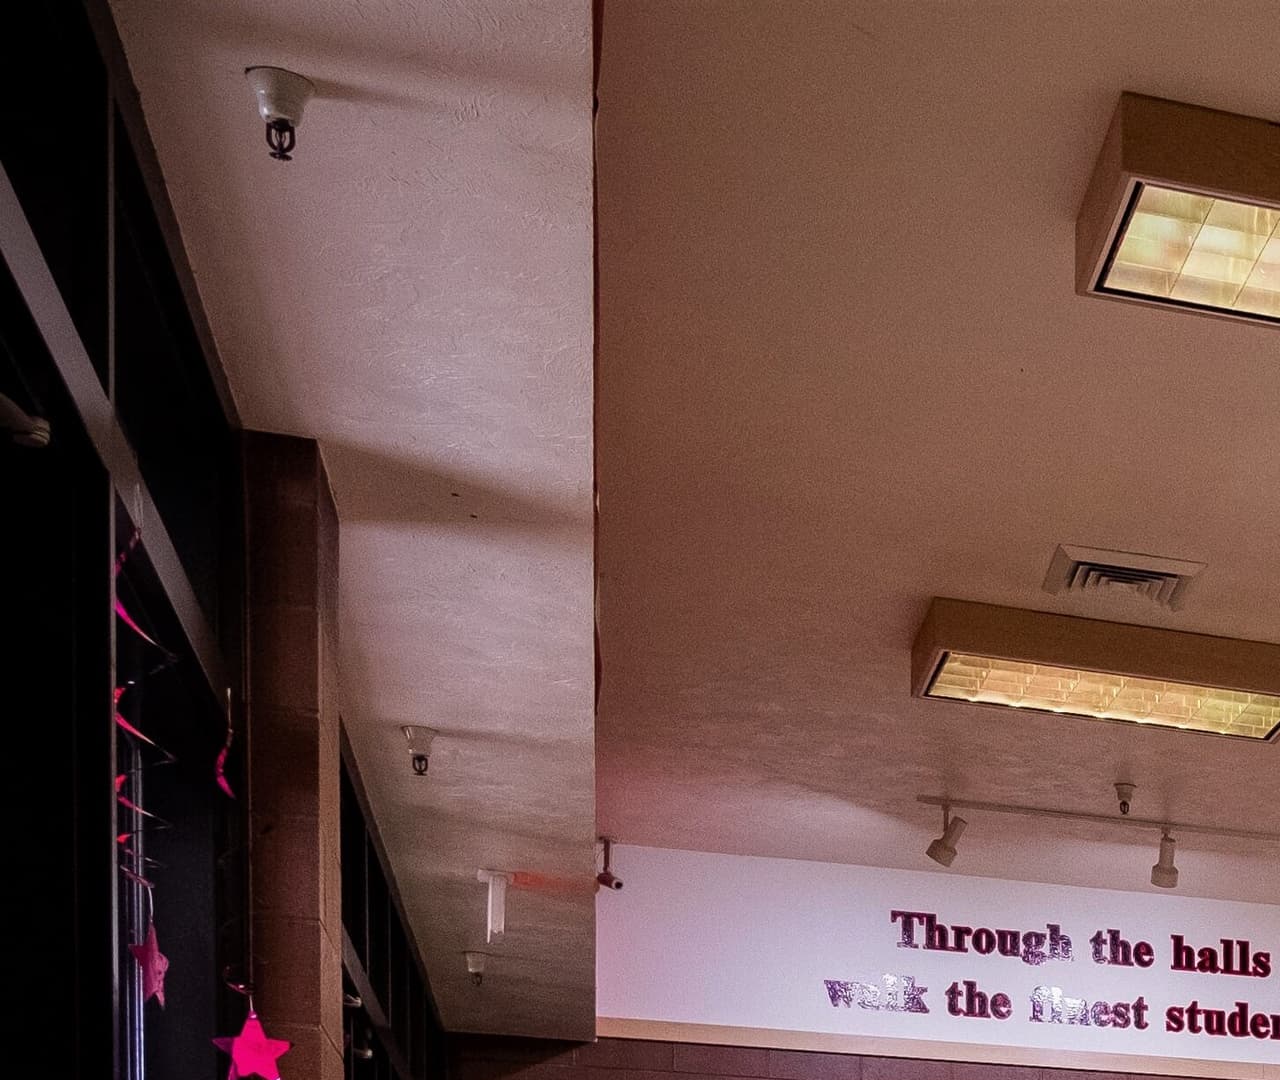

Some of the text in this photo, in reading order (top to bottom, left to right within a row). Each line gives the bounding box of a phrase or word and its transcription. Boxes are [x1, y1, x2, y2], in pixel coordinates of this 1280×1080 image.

[891, 910, 1074, 964] Through
[1090, 928, 1155, 968] the
[1171, 935, 1273, 980] halls
[823, 973, 930, 1014] walk
[945, 980, 1013, 1020] the
[1028, 984, 1150, 1031] finest
